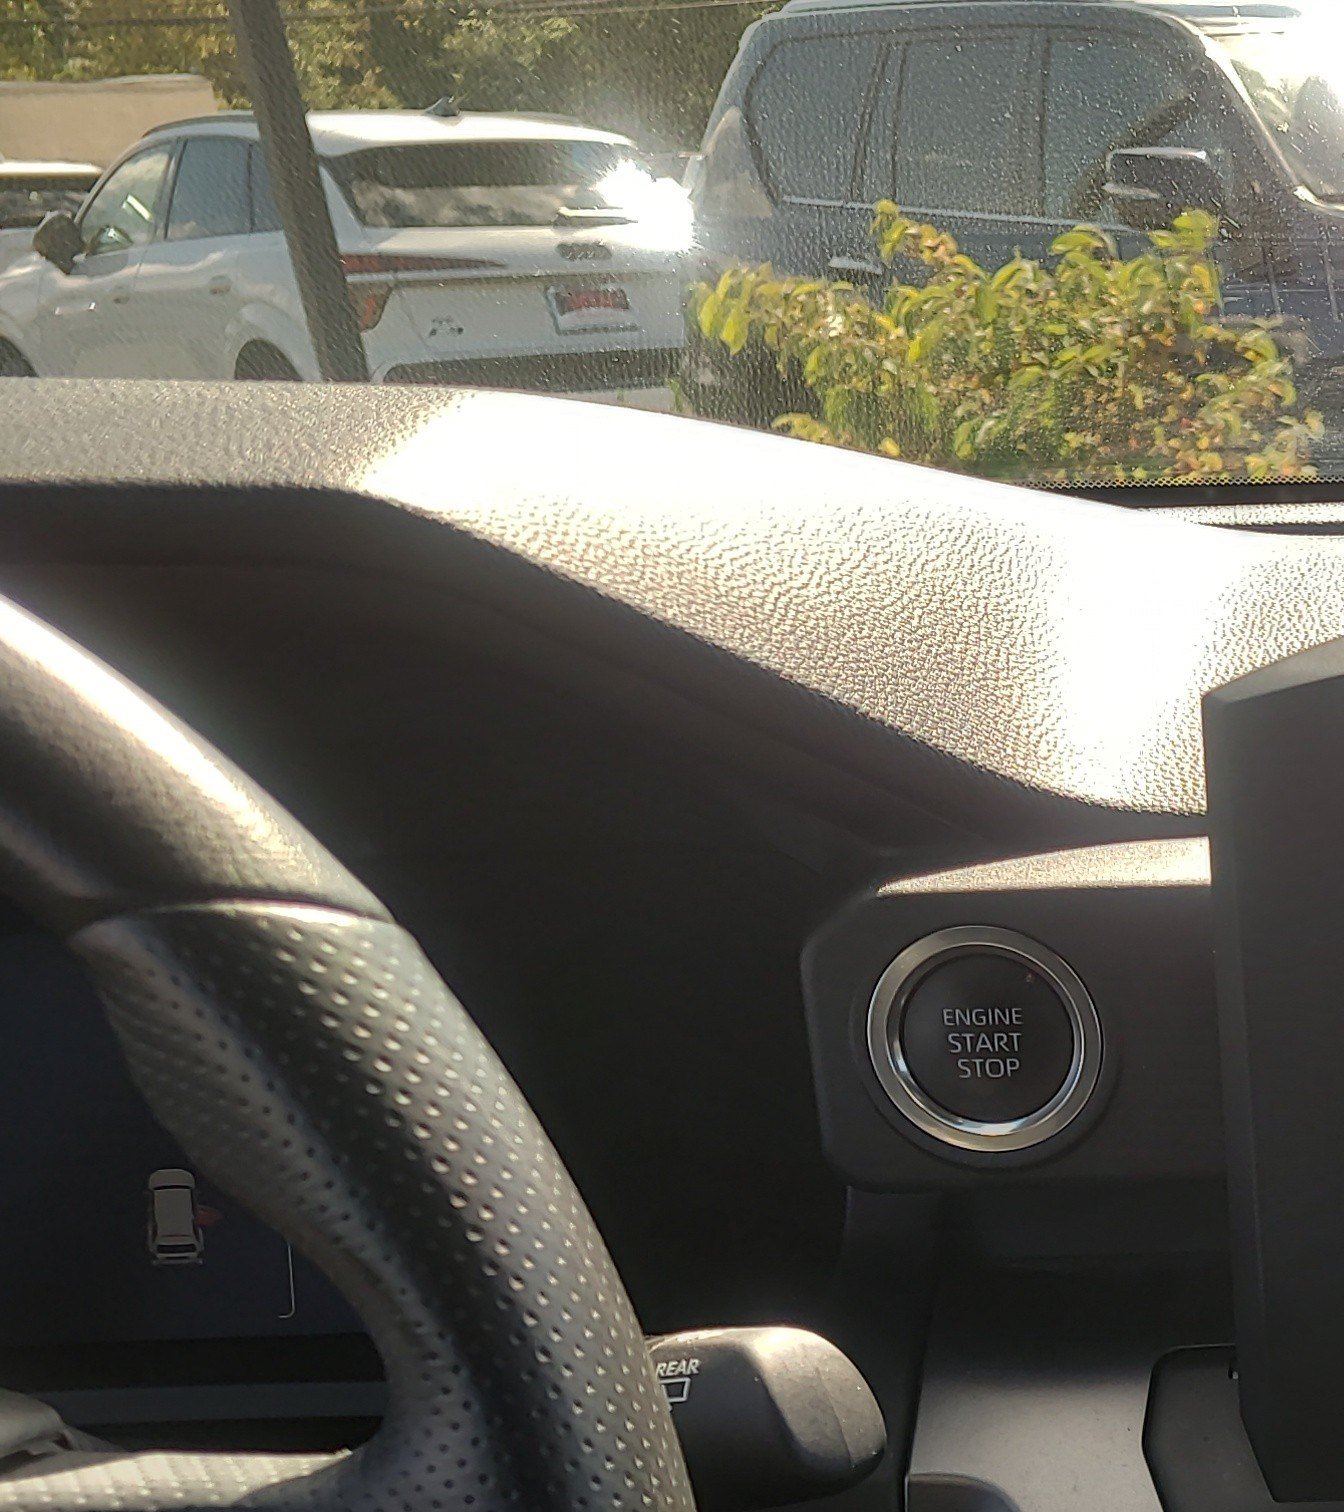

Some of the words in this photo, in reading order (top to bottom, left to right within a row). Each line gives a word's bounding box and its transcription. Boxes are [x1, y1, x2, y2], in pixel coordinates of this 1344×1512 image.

[942, 1007, 1023, 1026] ENGINE
[947, 1032, 1022, 1053] START
[957, 1058, 1021, 1079] STOP
[656, 1358, 701, 1377] REAR
